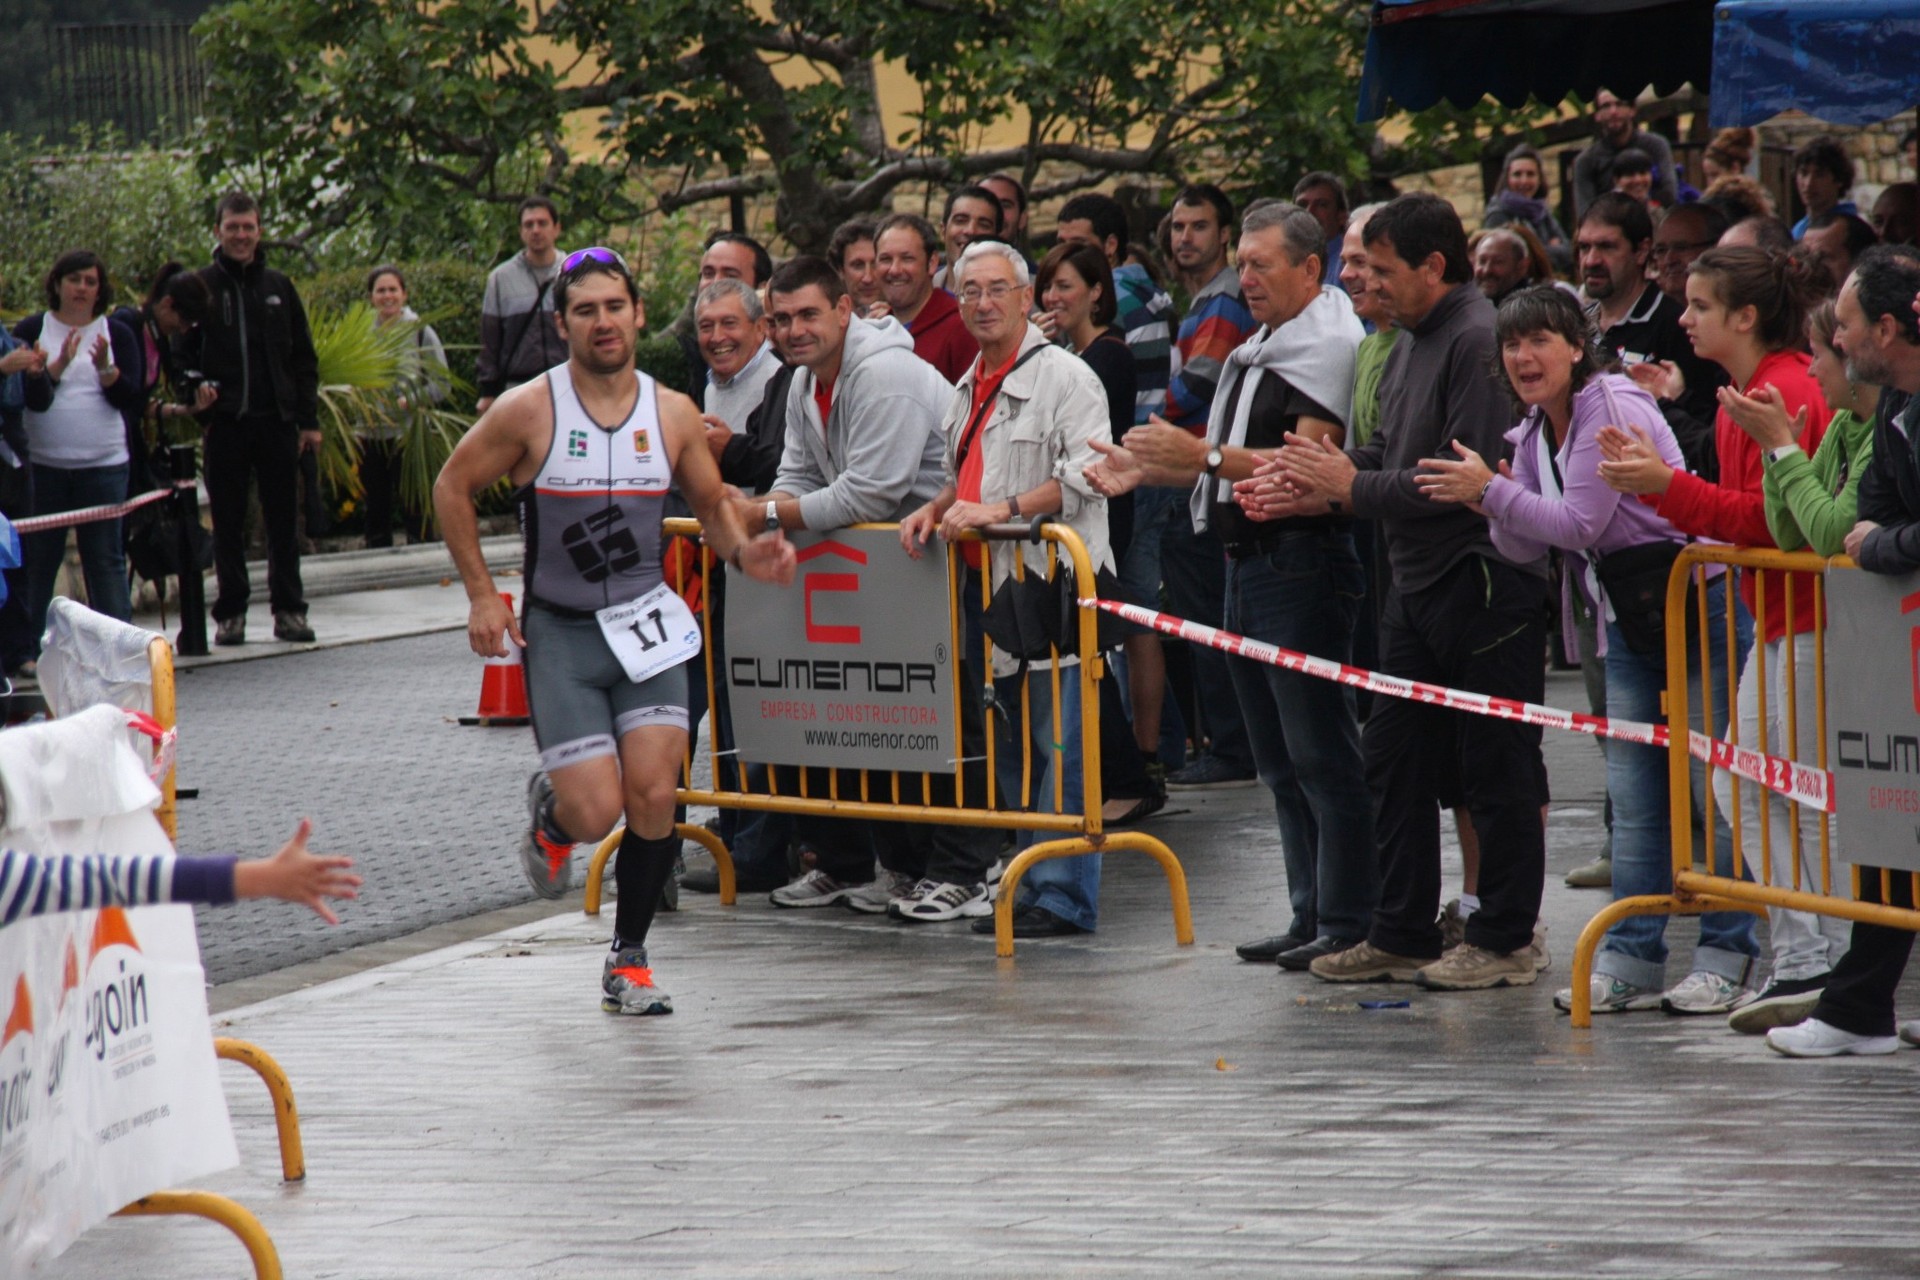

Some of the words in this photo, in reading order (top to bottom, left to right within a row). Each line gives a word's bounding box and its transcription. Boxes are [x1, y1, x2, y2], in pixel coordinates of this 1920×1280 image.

[628, 607, 668, 652] 17
[731, 656, 937, 694] CUMENOR
[761, 699, 817, 721] EMPRESA
[826, 702, 938, 726] CONSTRUCTORA
[804, 728, 939, 751] www.cumenor.com
